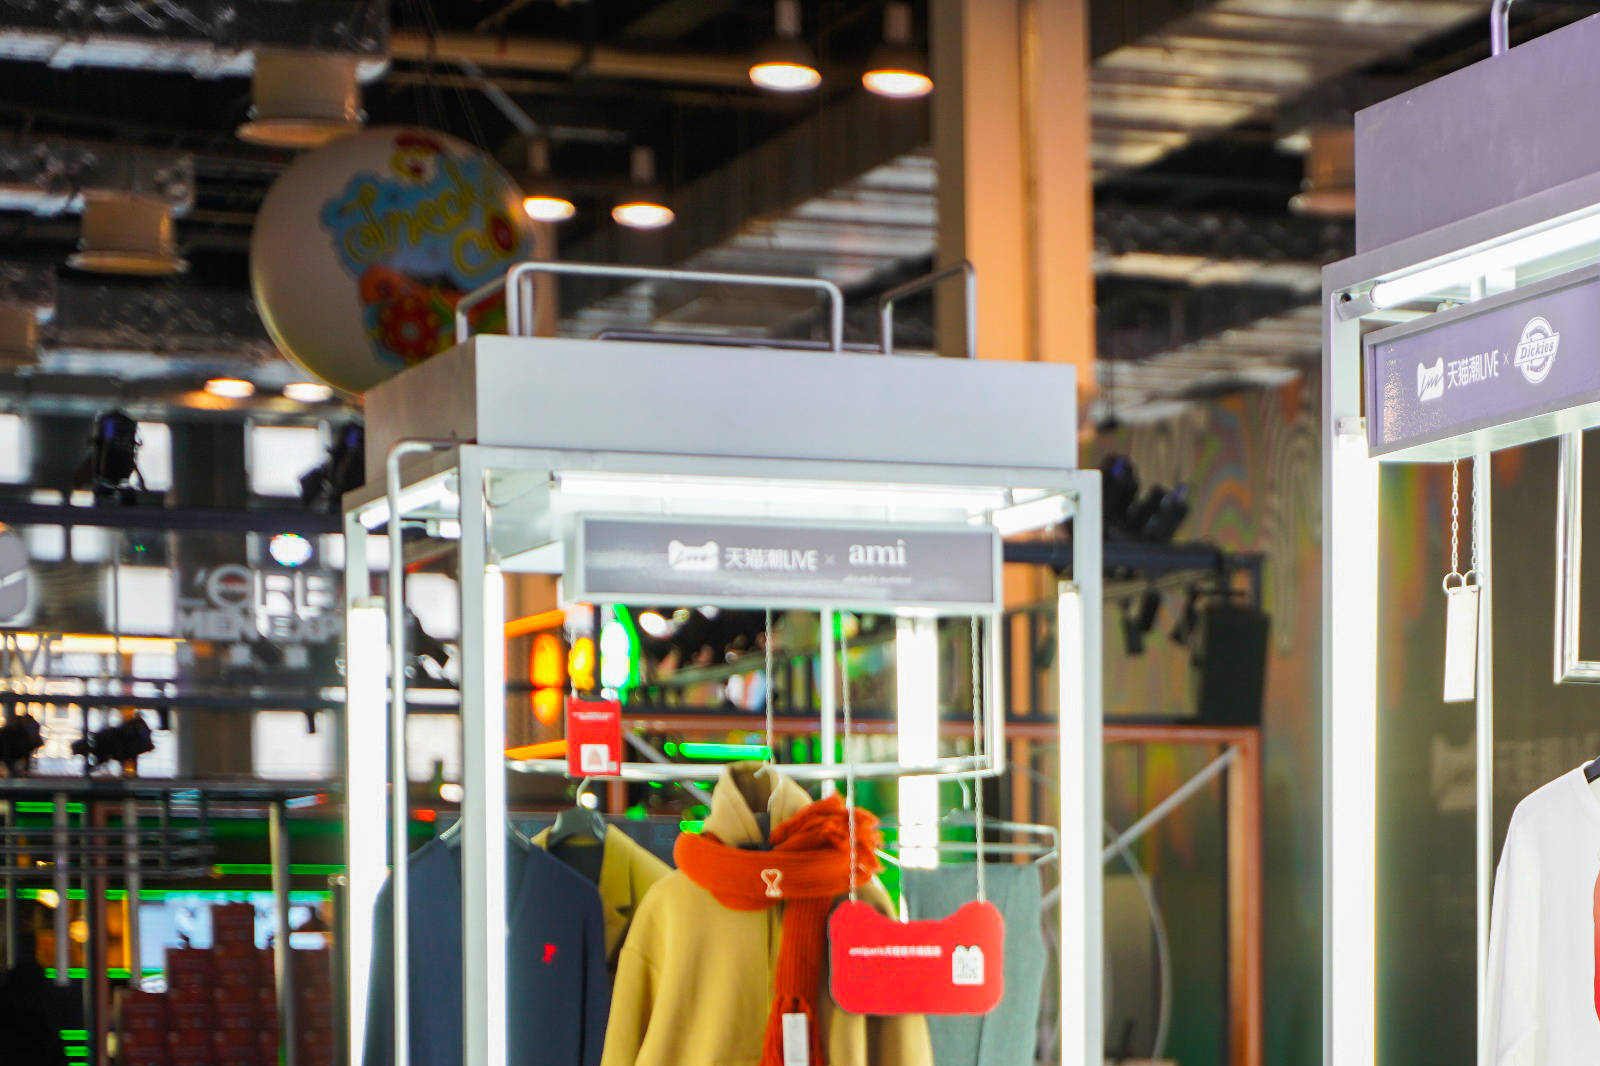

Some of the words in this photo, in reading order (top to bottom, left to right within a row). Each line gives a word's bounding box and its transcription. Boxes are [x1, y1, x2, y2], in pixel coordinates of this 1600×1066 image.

[1447, 350, 1499, 389] 天猫潮LIVE
[1519, 341, 1555, 360] Dickies
[849, 539, 907, 567] ami
